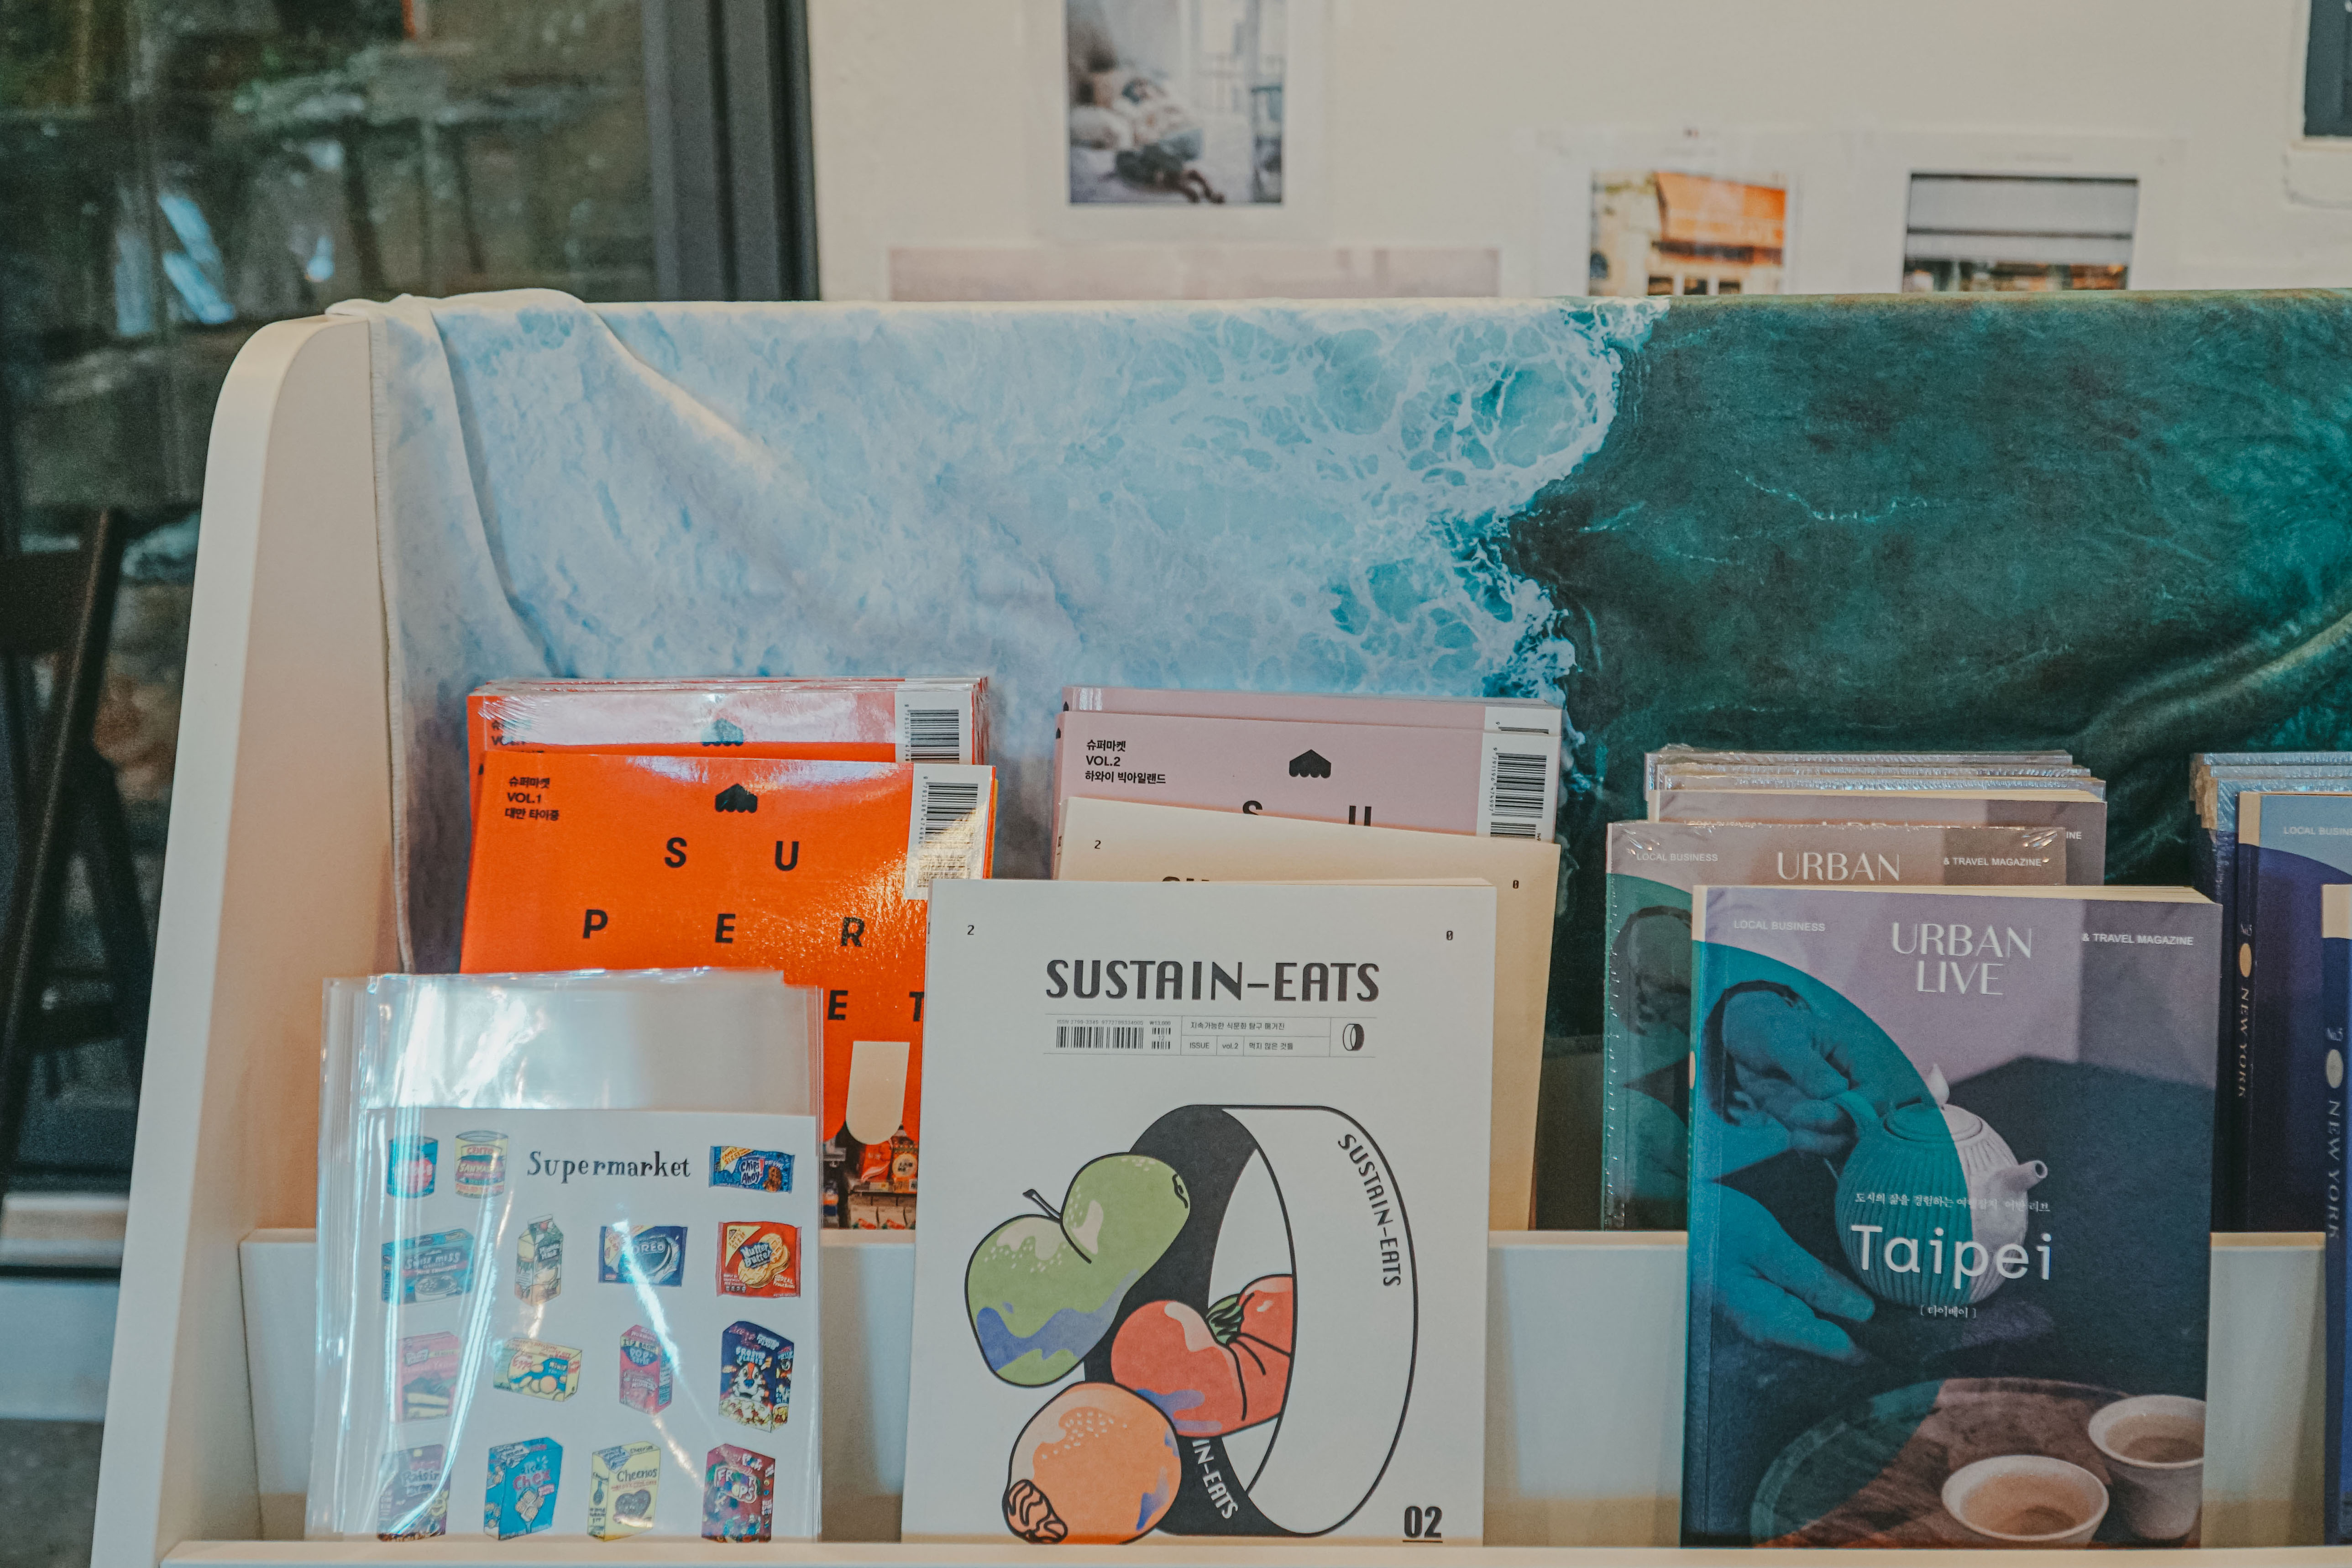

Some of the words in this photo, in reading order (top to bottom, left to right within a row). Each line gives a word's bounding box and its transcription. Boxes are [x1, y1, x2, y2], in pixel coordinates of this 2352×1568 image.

[1086, 739, 1126, 752] 슈퍼마켓
[1086, 755, 1121, 766] VOL.2
[509, 776, 550, 789] 슈퍼마켓
[1085, 771, 1114, 782] 하와이
[1117, 772, 1166, 784] 빅아일랜드
[507, 792, 541, 803] VOL.1
[505, 808, 526, 820] 대만
[2284, 826, 2315, 835] LOCAL
[1094, 840, 1101, 849] 2
[1637, 852, 1667, 861] LOCAL
[1670, 853, 1718, 862] BUSINESS
[1952, 857, 1990, 866] TRAVEL
[1991, 858, 2042, 867] MAGAZINE
[1777, 852, 1900, 881] URBAN
[967, 925, 974, 935] 2
[1734, 920, 1768, 930] LOCAL
[1771, 921, 1825, 932] BUSINESS
[1892, 922, 2032, 959] URBAN
[2082, 933, 2090, 942] &
[2092, 933, 2135, 944] TRAVEL
[2137, 935, 2194, 946] MAGAZINE
[1046, 960, 1379, 1002] SUSTAIN-EATS
[1917, 960, 2004, 995] LIVE
[2239, 987, 2249, 1038] NEW
[1190, 1022, 1224, 1030] 지속가능한
[2238, 1044, 2247, 1097] YORK
[2327, 1099, 2341, 1161] NEW
[527, 1150, 691, 1184] Supermarket
[1854, 1191, 1886, 1205] 도시의
[2327, 1169, 2340, 1239] YORK
[1337, 1133, 1401, 1287] SUSTAIN-EATS
[1851, 1225, 2052, 1290] Taipei
[513, 1468, 551, 1491] Chex
[1404, 1506, 1443, 1538] 02
